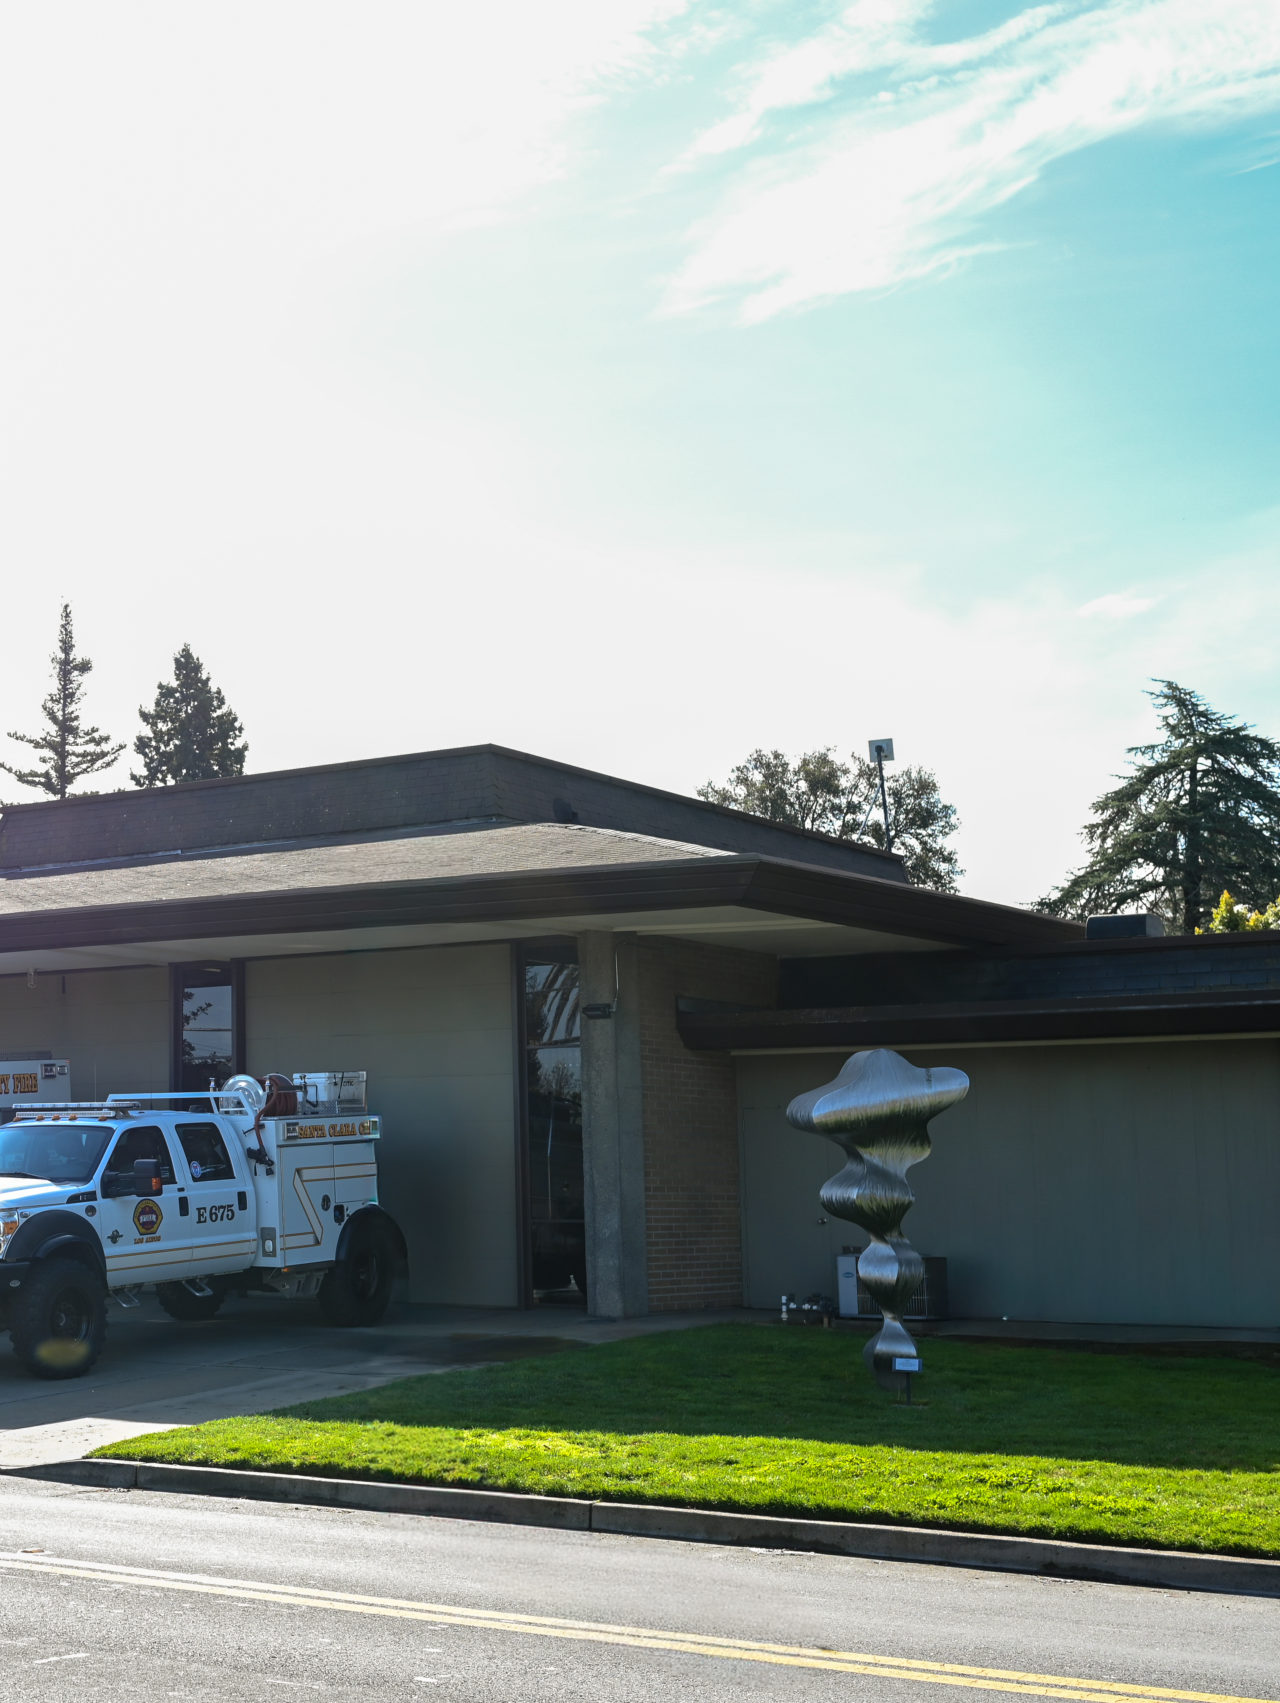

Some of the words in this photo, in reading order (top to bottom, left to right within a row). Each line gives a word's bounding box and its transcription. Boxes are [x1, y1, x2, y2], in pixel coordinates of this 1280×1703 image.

[13, 1073, 38, 1093] FIRE
[298, 1124, 327, 1138] SANTA
[328, 1122, 357, 1137] CLARA
